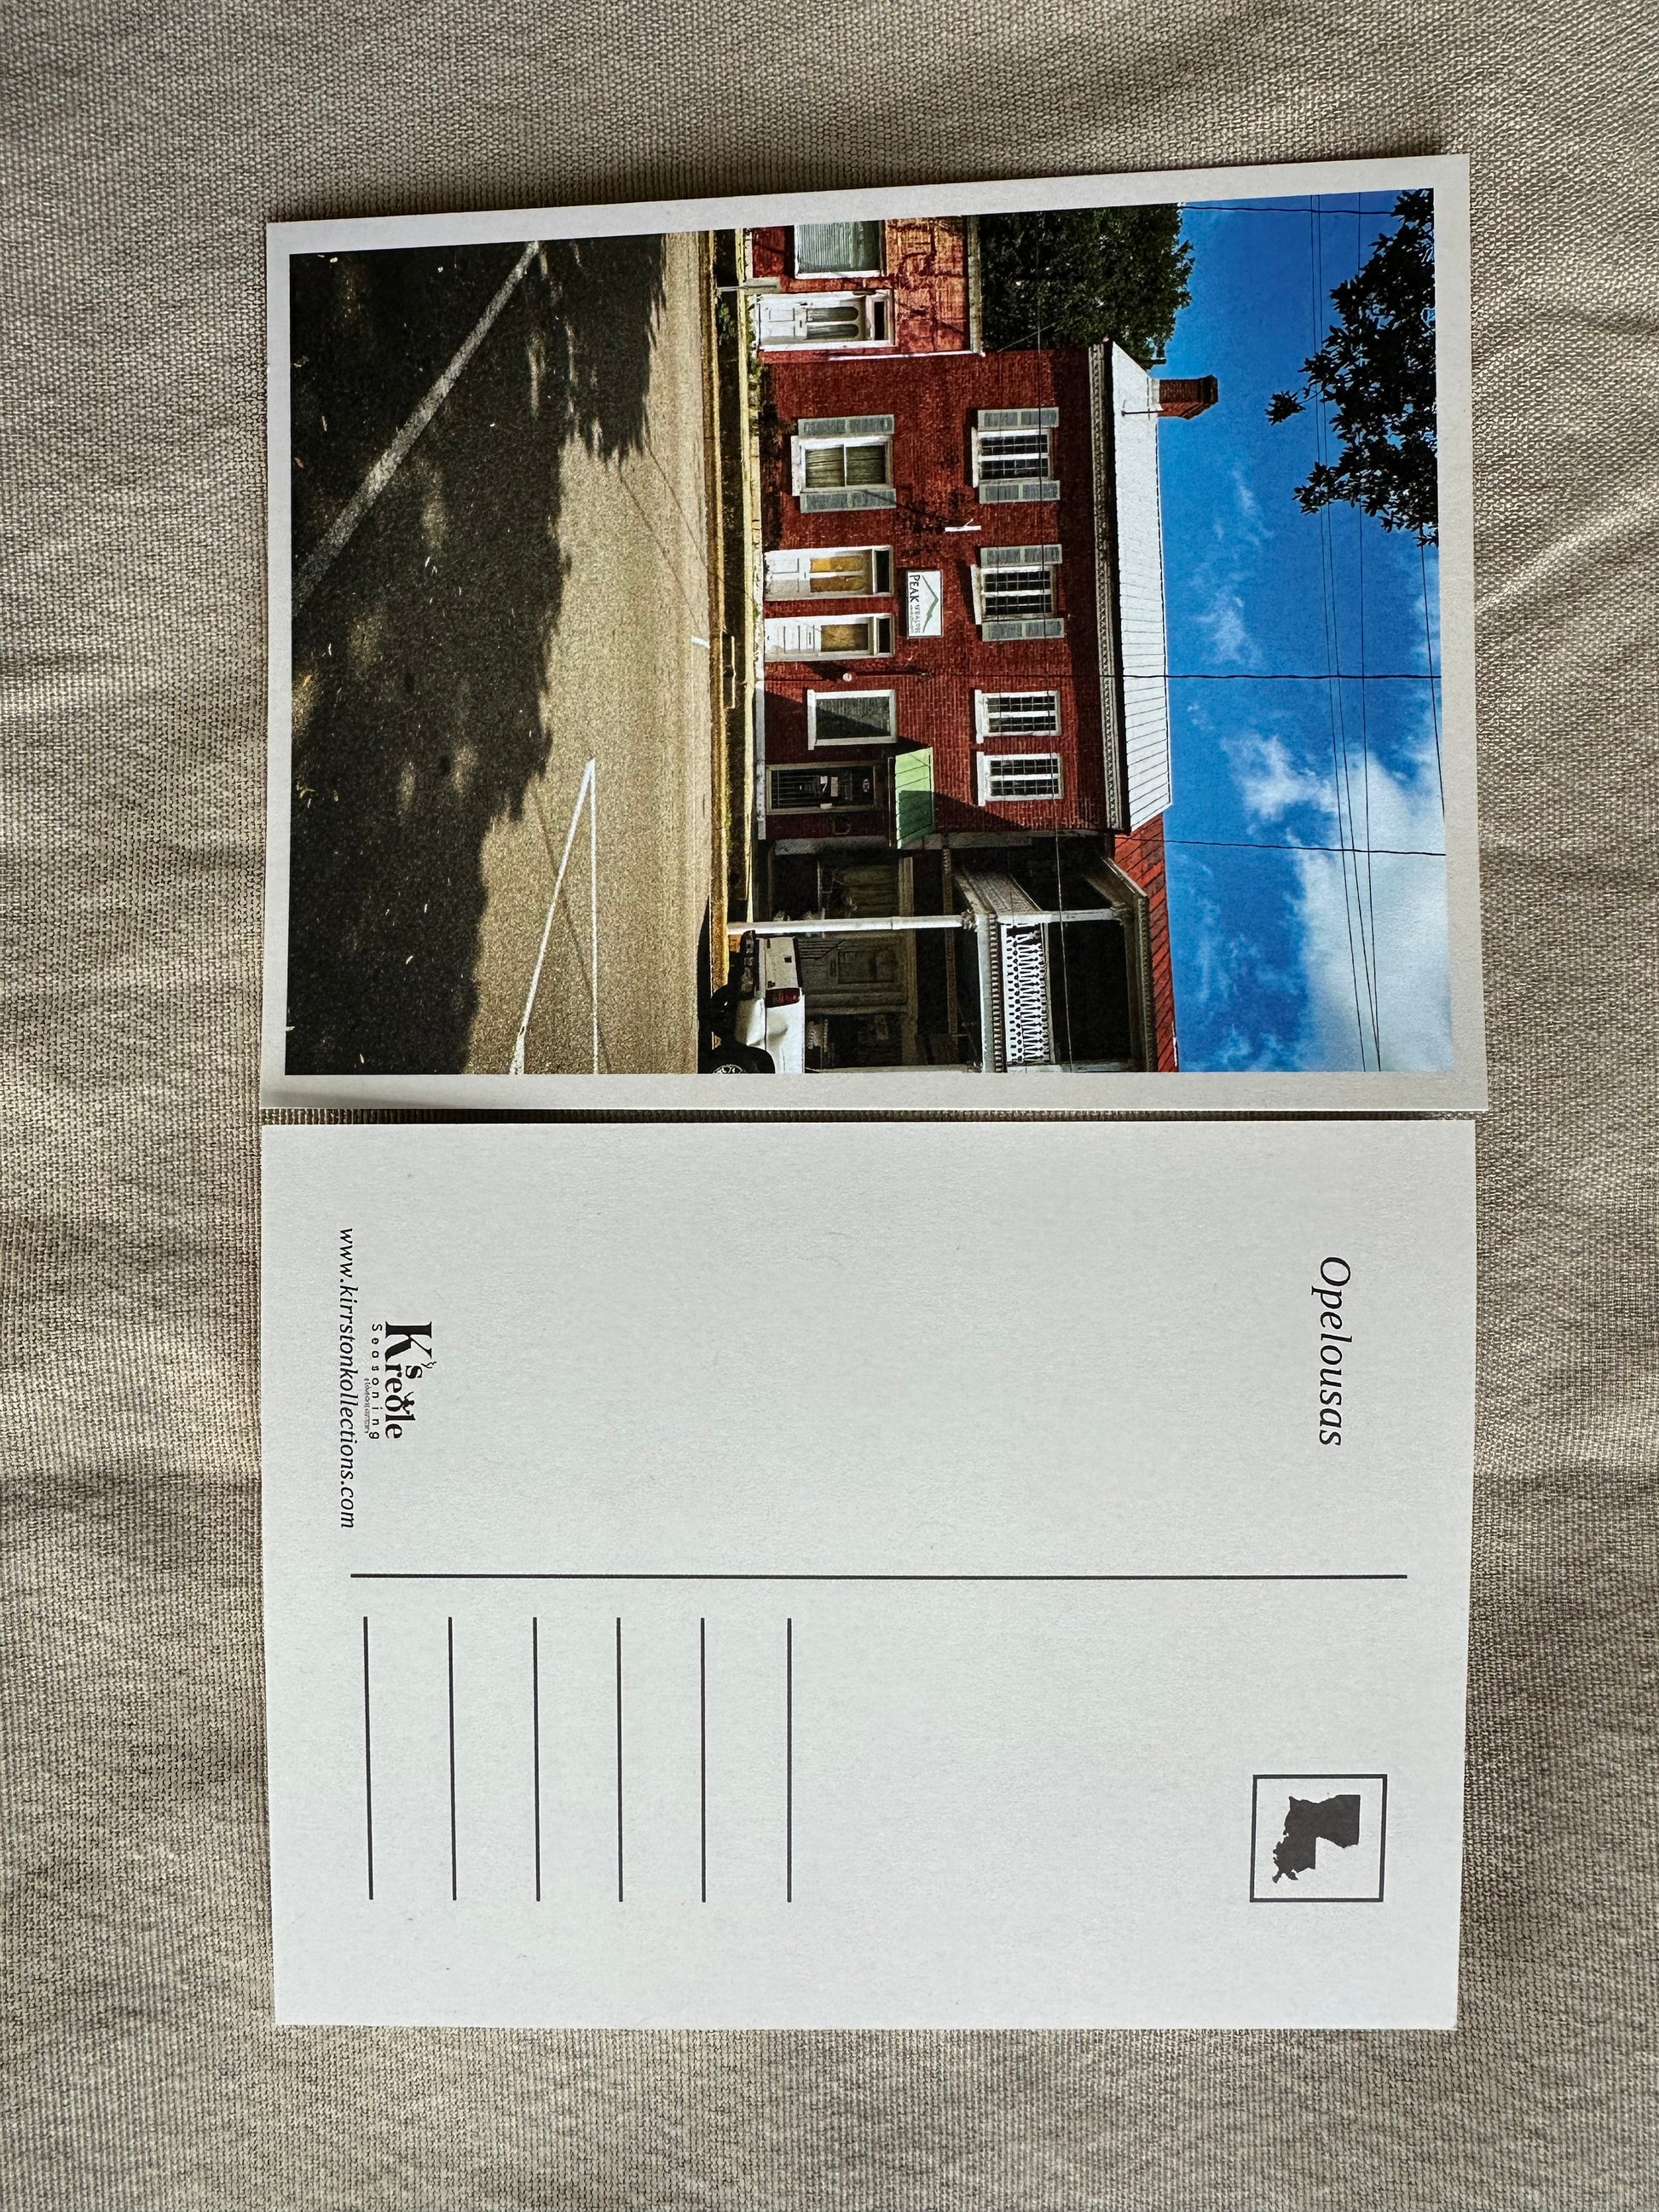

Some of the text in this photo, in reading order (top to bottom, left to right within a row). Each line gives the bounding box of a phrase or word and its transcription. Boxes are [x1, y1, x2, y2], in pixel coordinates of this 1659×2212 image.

[910, 575, 920, 603] PEAK
[339, 1227, 359, 1528] www.kirrstonkollections.com
[368, 1323, 383, 1440] Seasoning
[1311, 1256, 1353, 1446] Opelousas
